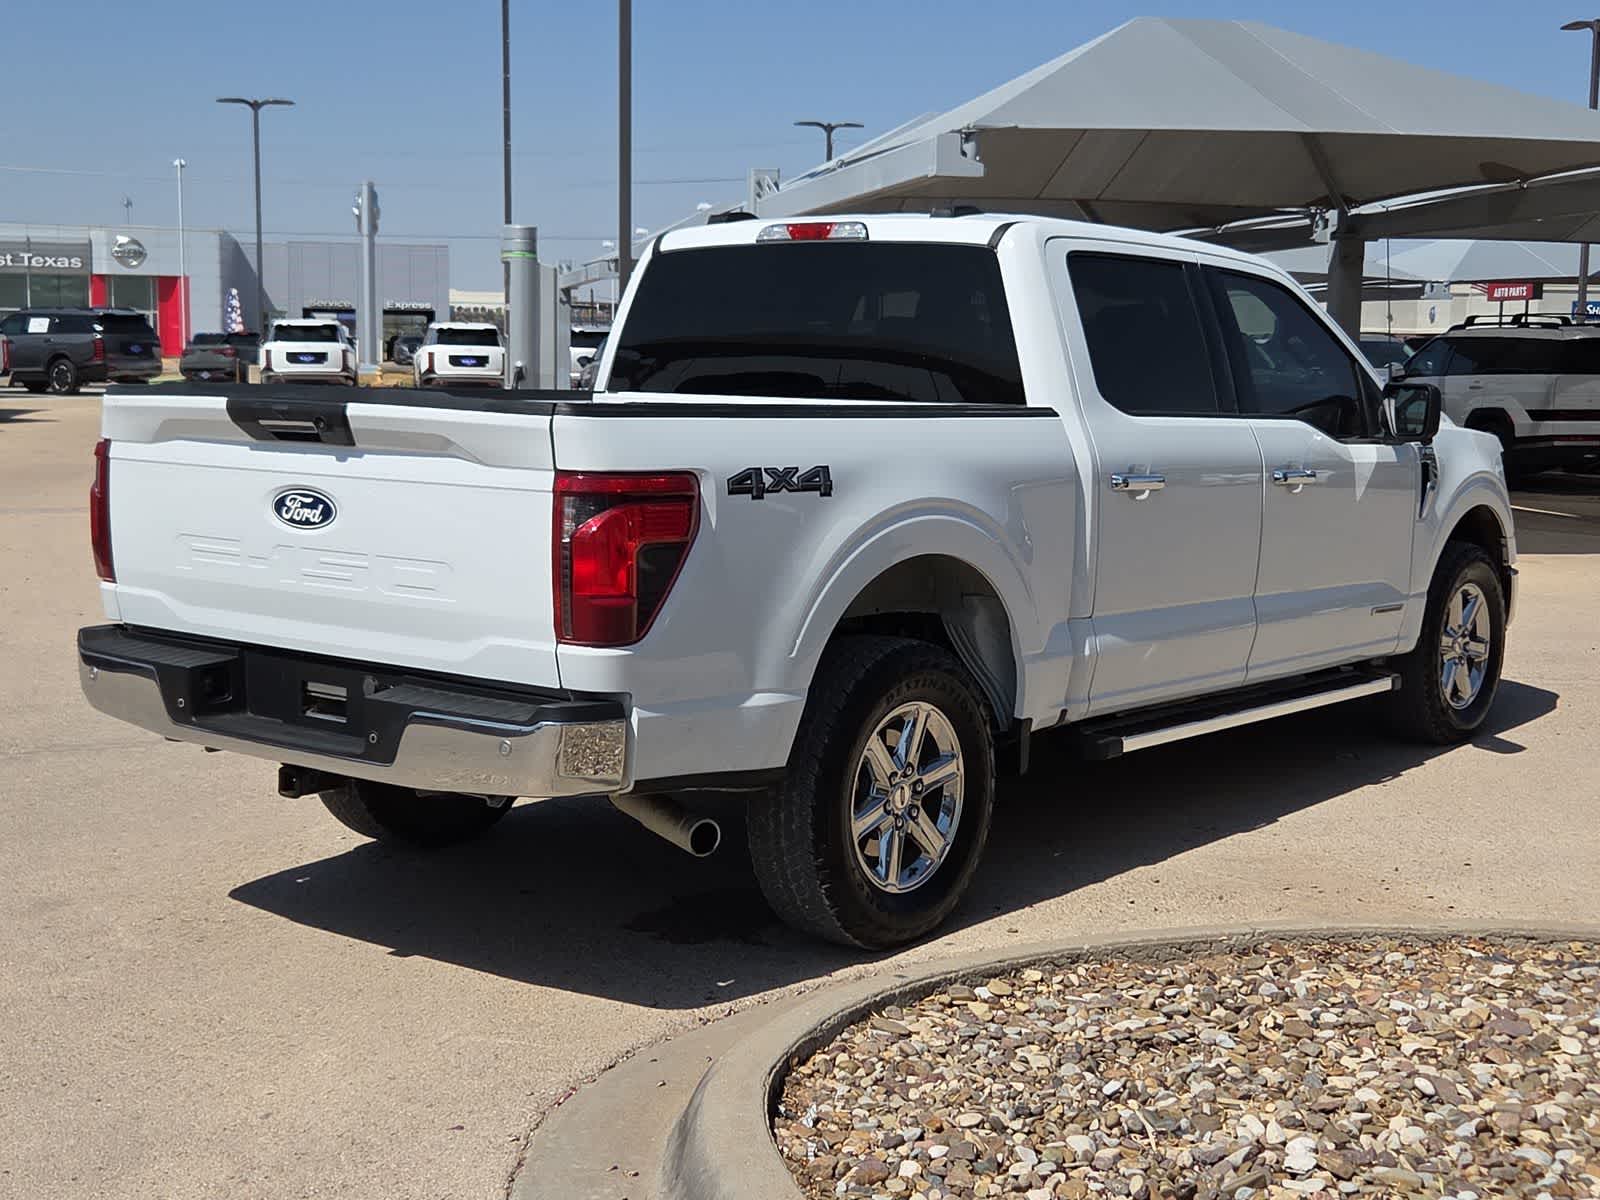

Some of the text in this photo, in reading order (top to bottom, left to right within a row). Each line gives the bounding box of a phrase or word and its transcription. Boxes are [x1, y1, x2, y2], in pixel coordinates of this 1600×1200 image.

[19, 252, 83, 268] Texas
[1493, 286, 1527, 298] AUTO PARTS
[311, 298, 432, 310] Service Express
[278, 492, 328, 526] Ford
